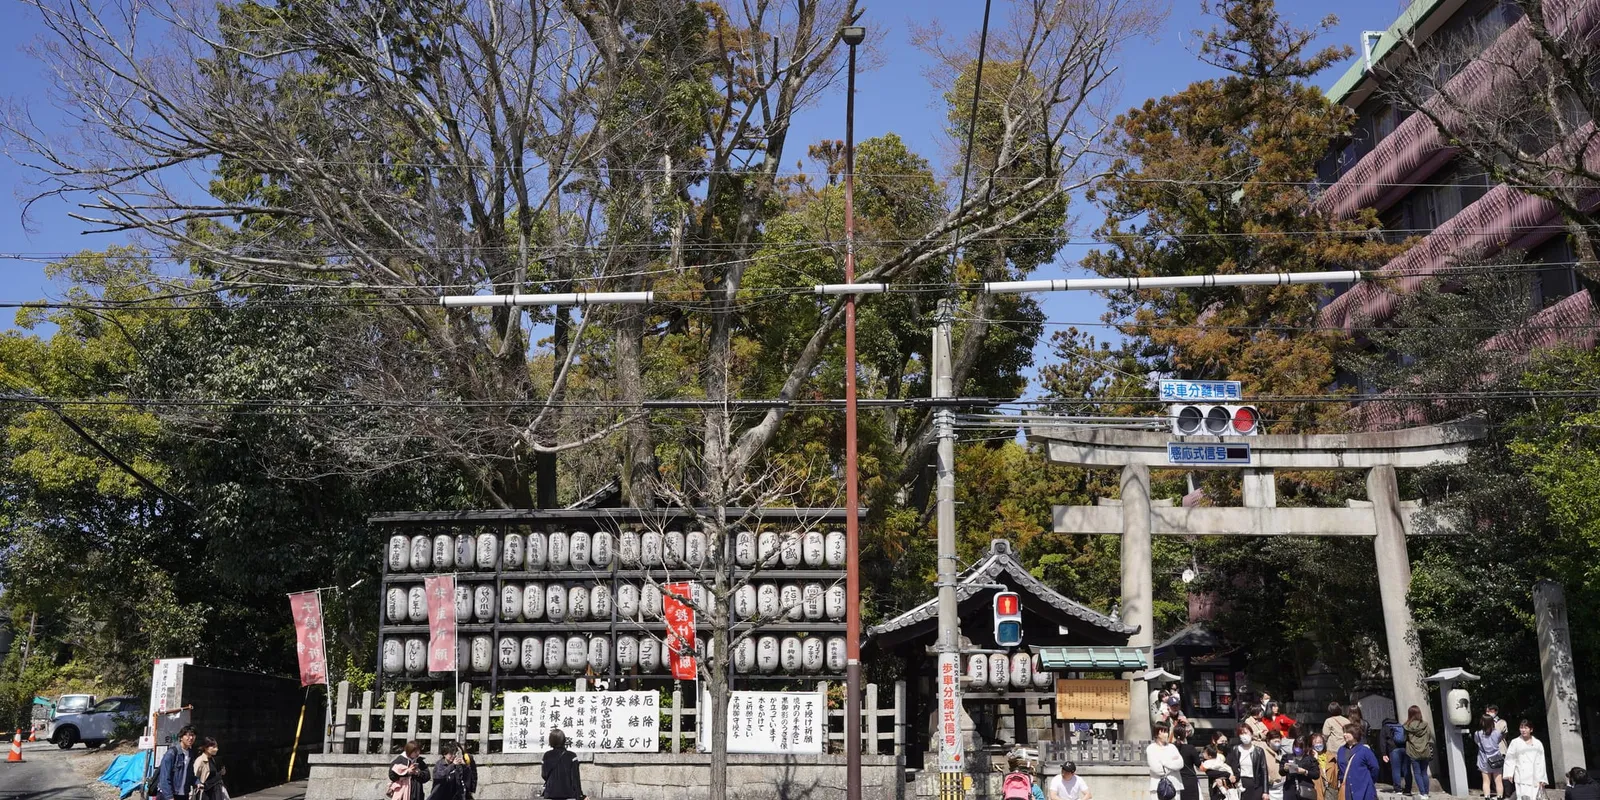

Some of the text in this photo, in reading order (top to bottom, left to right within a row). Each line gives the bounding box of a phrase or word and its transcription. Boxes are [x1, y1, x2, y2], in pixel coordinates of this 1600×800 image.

[1163, 383, 1237, 398] 歩車分離信号
[1170, 446, 1227, 460] 感応式信号
[500, 638, 513, 666] 八百仙
[762, 640, 771, 664] 宮下
[518, 705, 529, 749] 岡崎神社
[562, 695, 575, 749] 地鎮祭
[574, 695, 586, 748] 各種出張祭
[600, 695, 613, 750] 初宮詣り他
[613, 695, 626, 749] 安産
[628, 694, 641, 748] 縁結び
[642, 695, 655, 748] 厄除け
[756, 696, 766, 732] 水をかけて
[769, 696, 778, 743] が立っています
[803, 701, 813, 744] 子授け祈願
[942, 663, 956, 747] 歩車分離式信号
